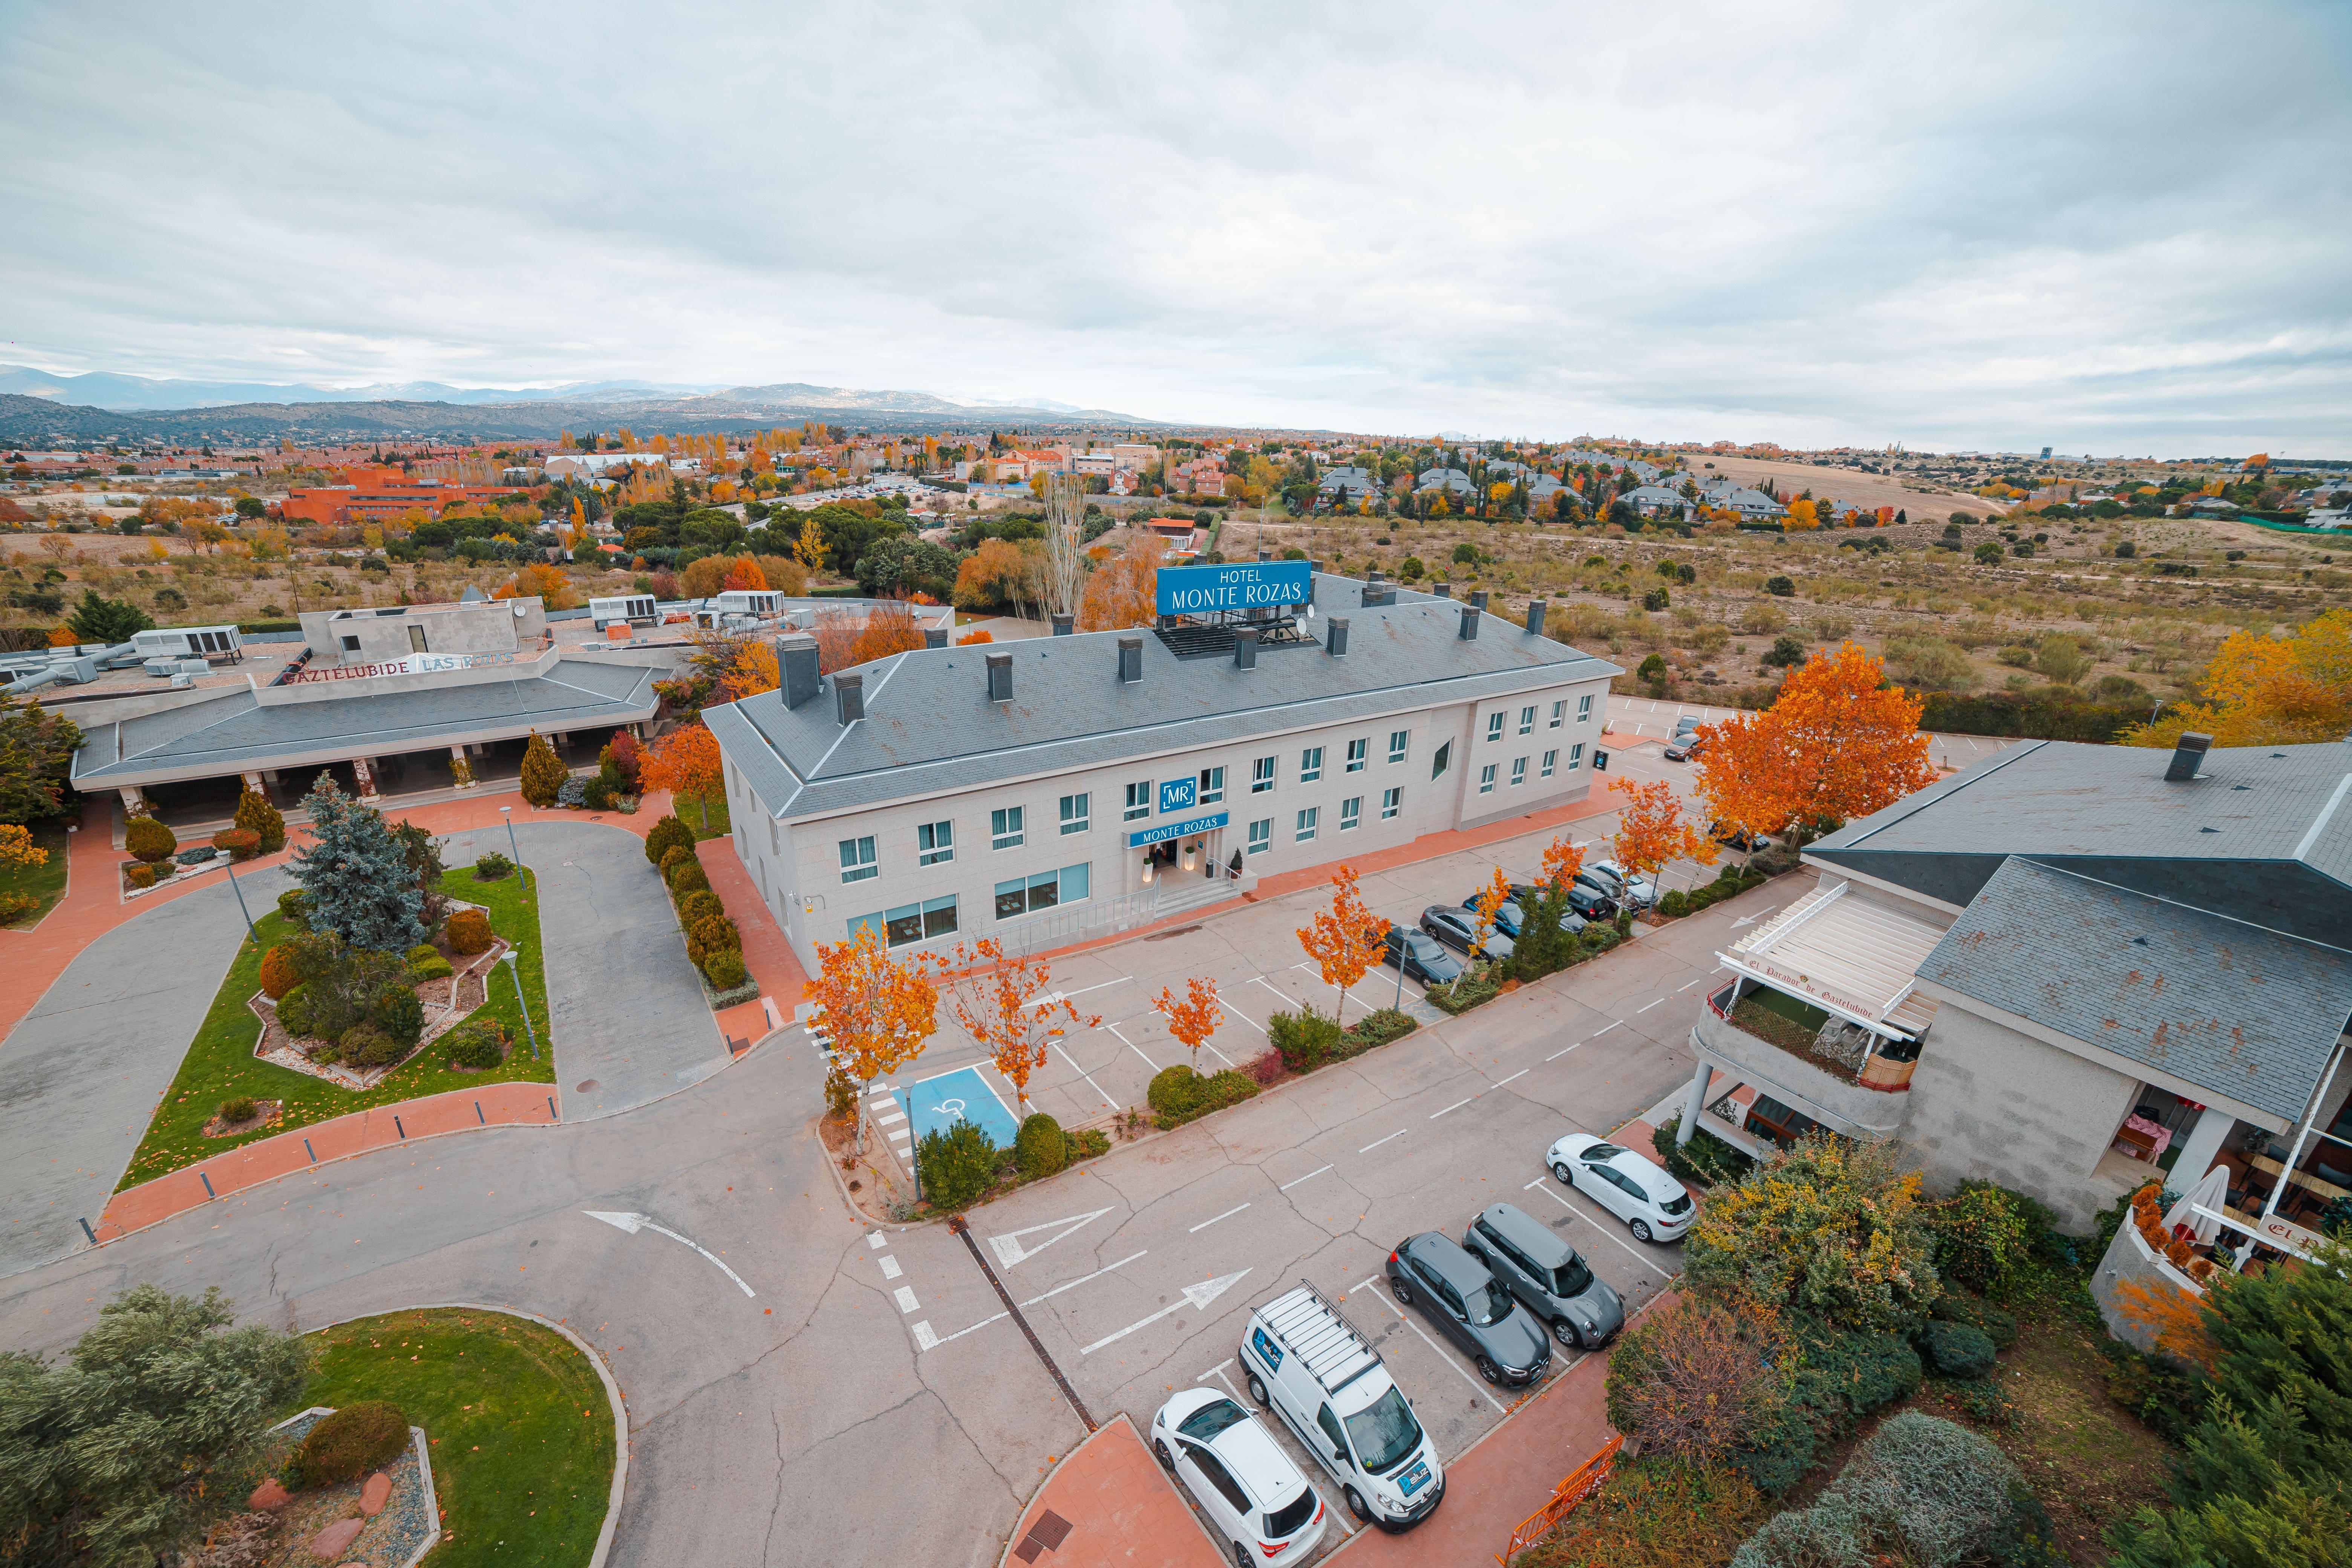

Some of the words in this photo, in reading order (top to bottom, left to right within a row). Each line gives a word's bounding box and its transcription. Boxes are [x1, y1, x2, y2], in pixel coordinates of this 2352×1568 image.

[1220, 570, 1262, 583] HOTEL
[1172, 586, 1237, 609] MONTE
[1246, 582, 1301, 603] ROZAS
[282, 662, 409, 684] GAZTELUBIDE
[422, 657, 455, 671] LAS
[464, 652, 515, 667] ROZAS
[1168, 786, 1188, 804] MR
[1143, 825, 1180, 843] MONTE
[1184, 817, 1217, 833] ROZAS
[1749, 959, 1759, 970] El
[1766, 966, 1801, 987] Parador
[1806, 984, 1815, 994] de
[1822, 991, 1873, 1018] Gaztelubide
[2268, 1223, 2293, 1239] El
[1254, 1331, 1280, 1364] Daluz
[1397, 1467, 1429, 1494] Daluz
